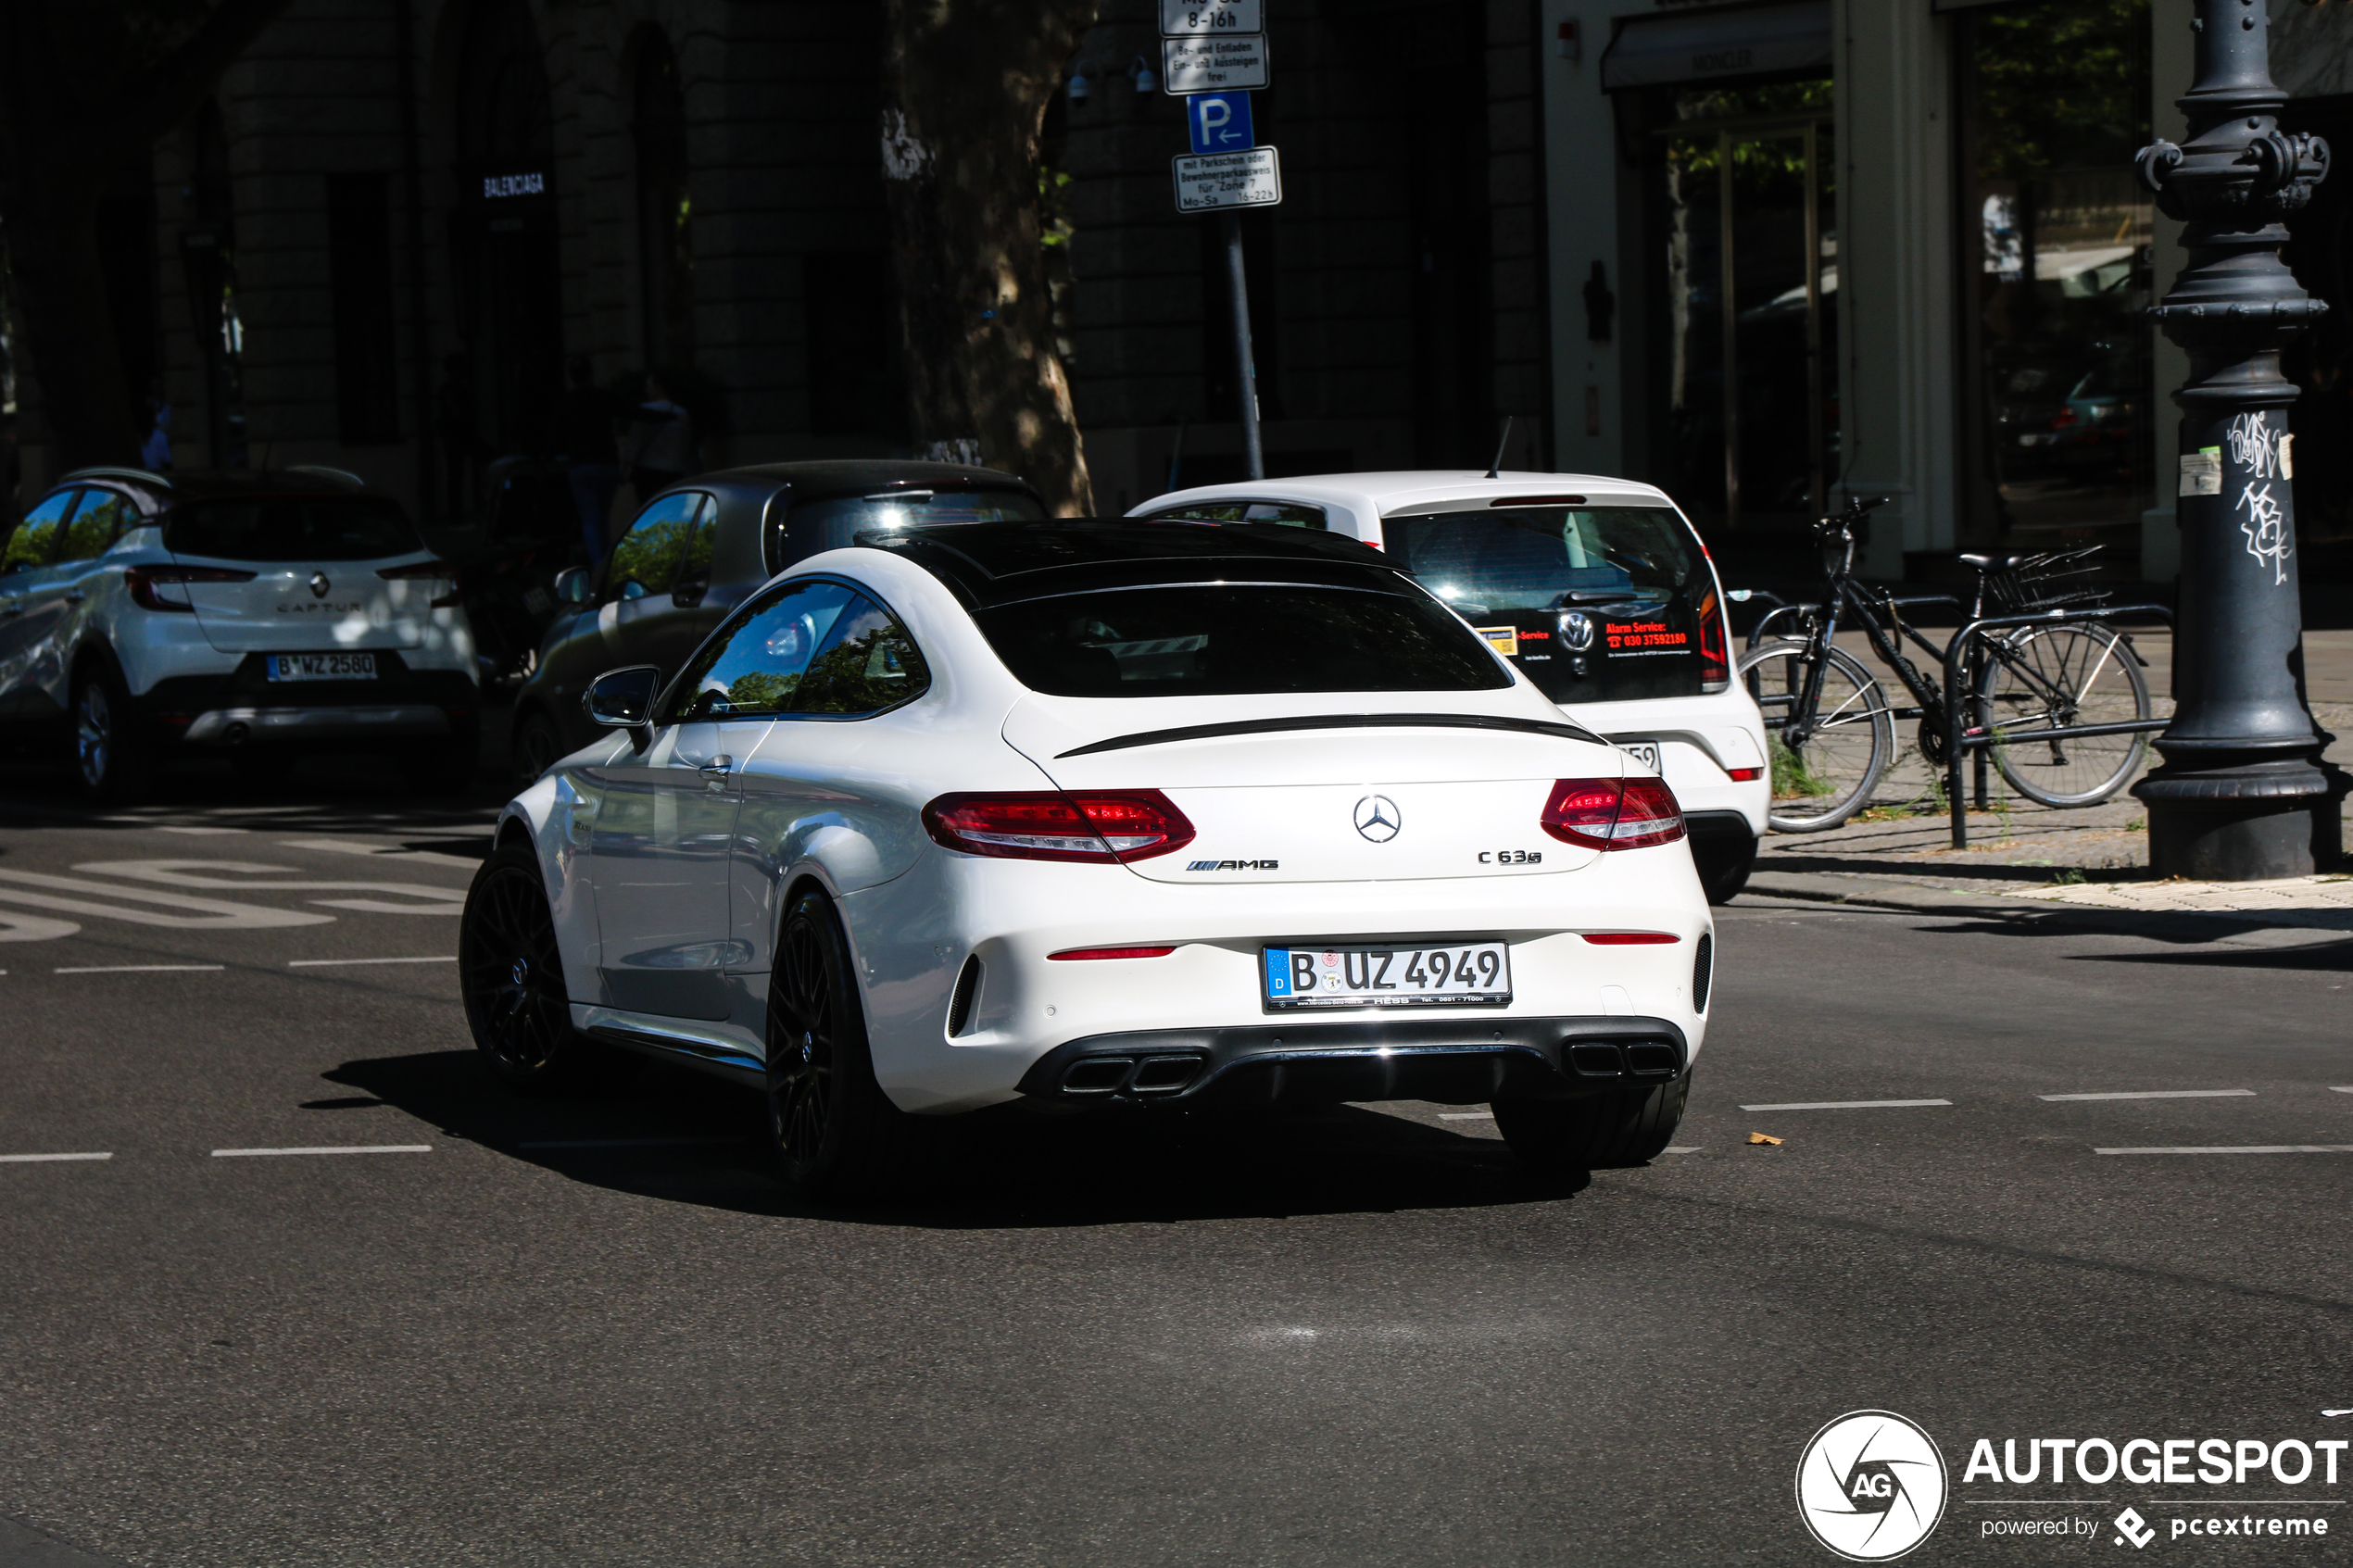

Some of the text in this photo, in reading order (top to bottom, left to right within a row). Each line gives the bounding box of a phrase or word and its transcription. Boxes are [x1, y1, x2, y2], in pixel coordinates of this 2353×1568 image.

[1177, 43, 1252, 56] Be- und Entladen
[1173, 56, 1259, 70] Ein- und Aussteigen
[1692, 50, 1753, 72] MONCLER
[1207, 71, 1227, 82] frei
[1199, 98, 1232, 146] P
[1183, 153, 1266, 169] mit Parkschein oder
[1180, 167, 1271, 183] Bewohnerparkausweis
[484, 173, 545, 198] BALENCIAGA
[1198, 178, 1256, 194] für Zone 7
[1183, 195, 1219, 207] Mo-Sa
[277, 602, 360, 613] CAPTUR
[1605, 621, 1667, 634] Alarm Service:
[1623, 632, 1687, 646] 030 37592180
[278, 654, 373, 675] B WZ 2580
[1477, 851, 1491, 864] C
[1215, 859, 1278, 872] AMG
[1290, 949, 1501, 992] B UZ 4949
[1275, 977, 1285, 990] D
[1374, 997, 1410, 1005] HESS
